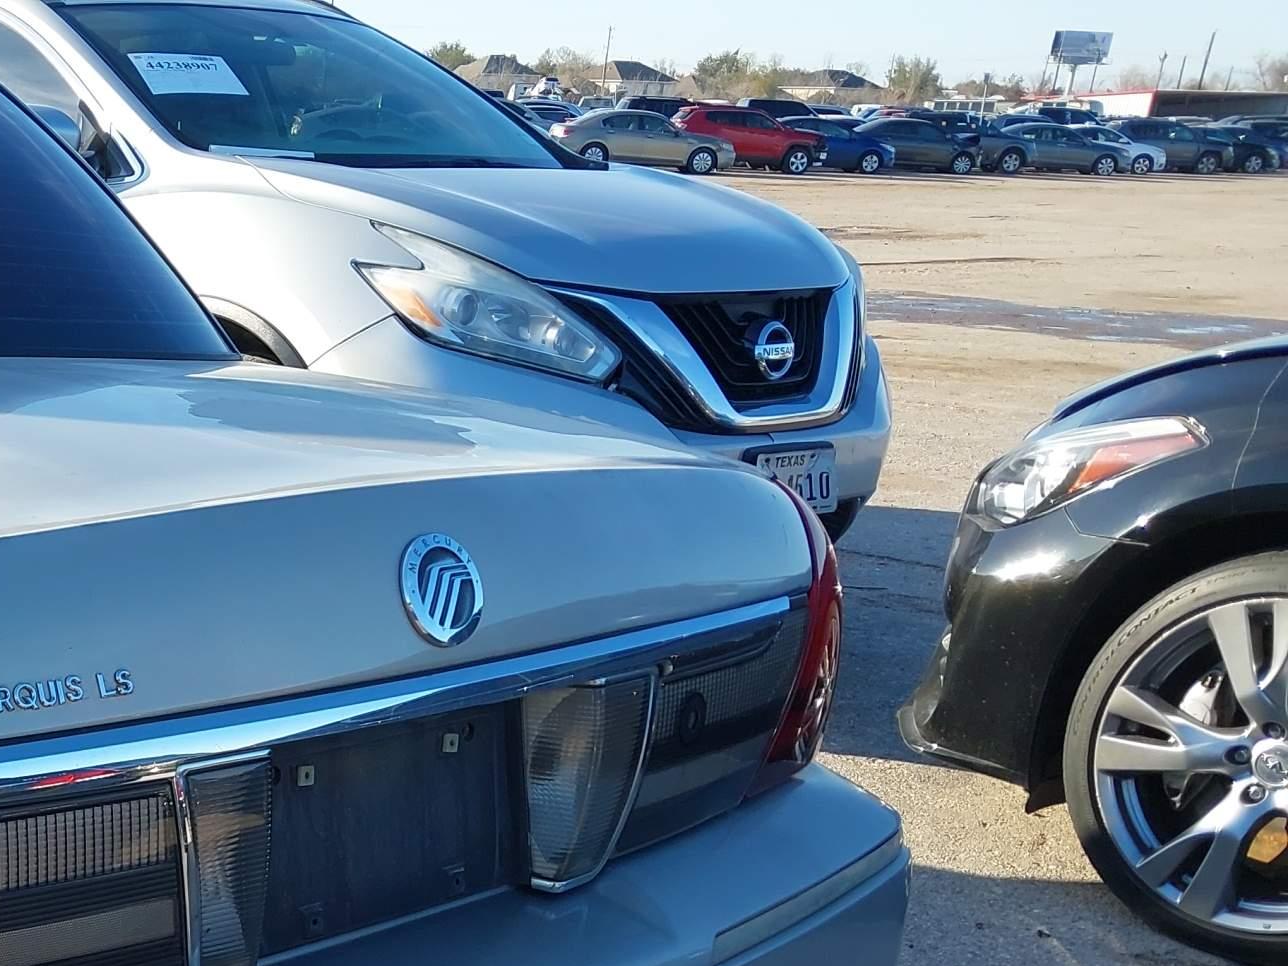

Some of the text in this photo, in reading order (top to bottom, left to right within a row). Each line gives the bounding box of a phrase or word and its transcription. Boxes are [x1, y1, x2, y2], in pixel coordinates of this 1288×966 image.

[146, 61, 217, 71] 44238907
[775, 454, 806, 469] TEXAS
[95, 668, 135, 699] LS
